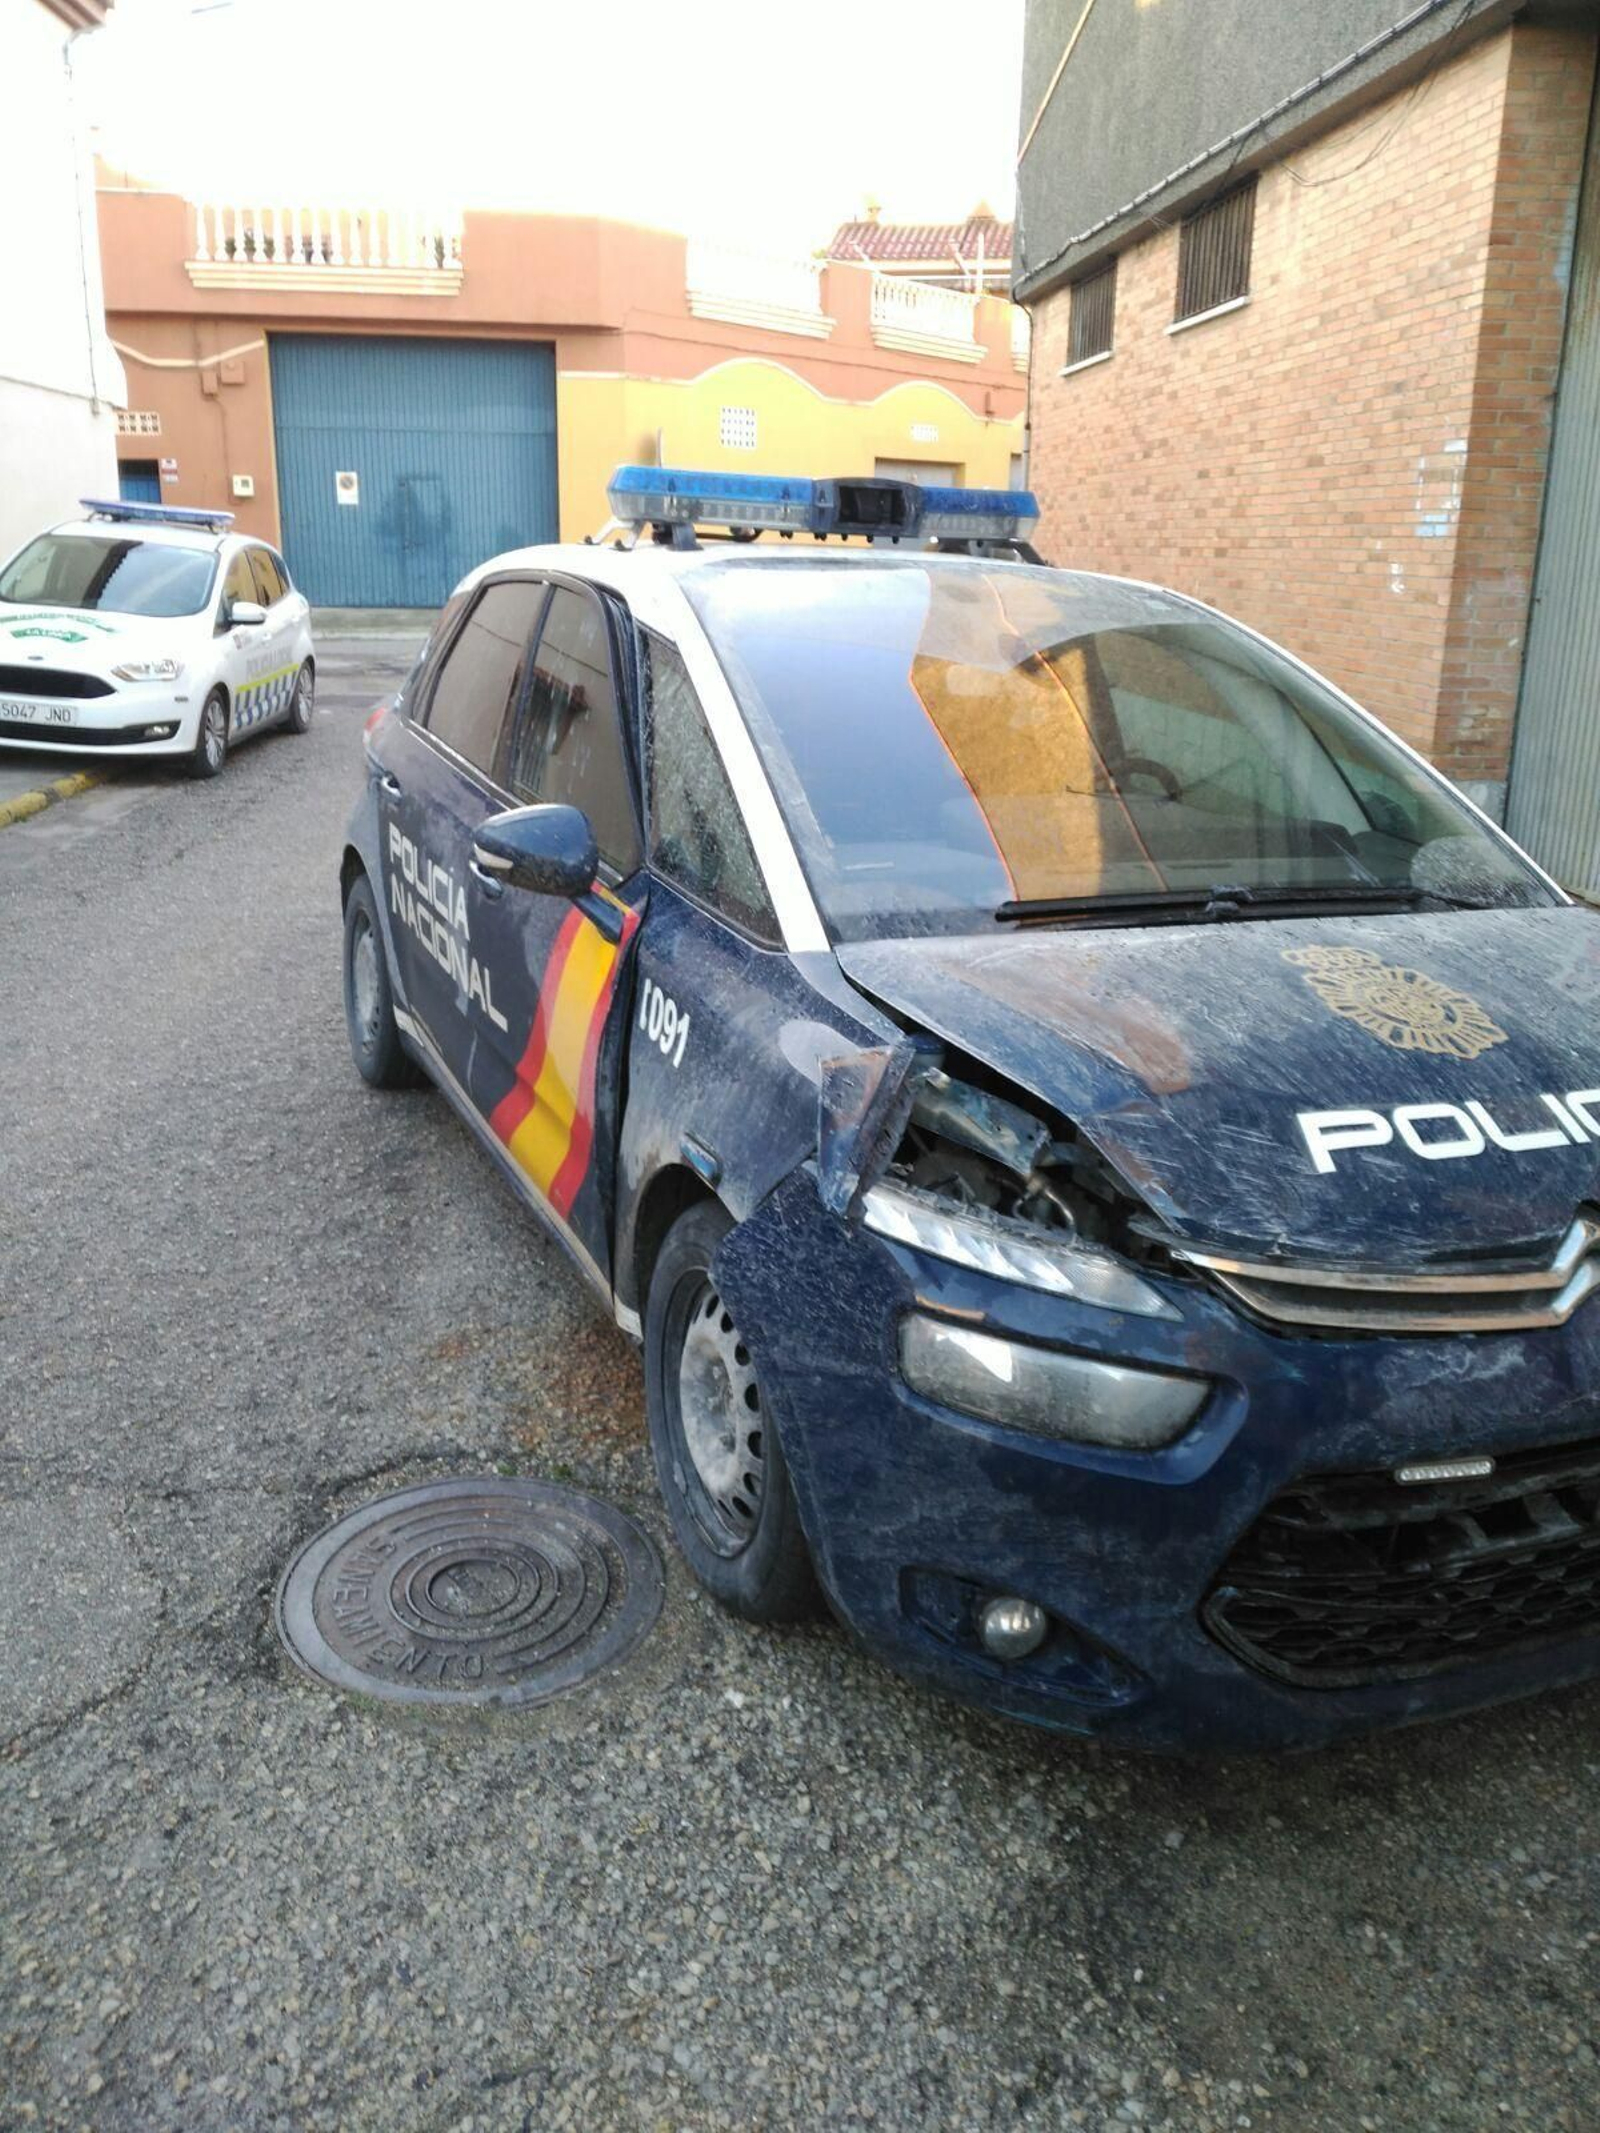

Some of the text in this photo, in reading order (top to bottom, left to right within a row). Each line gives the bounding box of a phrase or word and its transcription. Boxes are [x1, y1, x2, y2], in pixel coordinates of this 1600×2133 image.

[1, 702, 37, 720] 5047
[391, 872, 509, 1033] NACIONAL
[639, 978, 690, 1069] 1091
[332, 1536, 485, 1680] SANEAMIENTO
